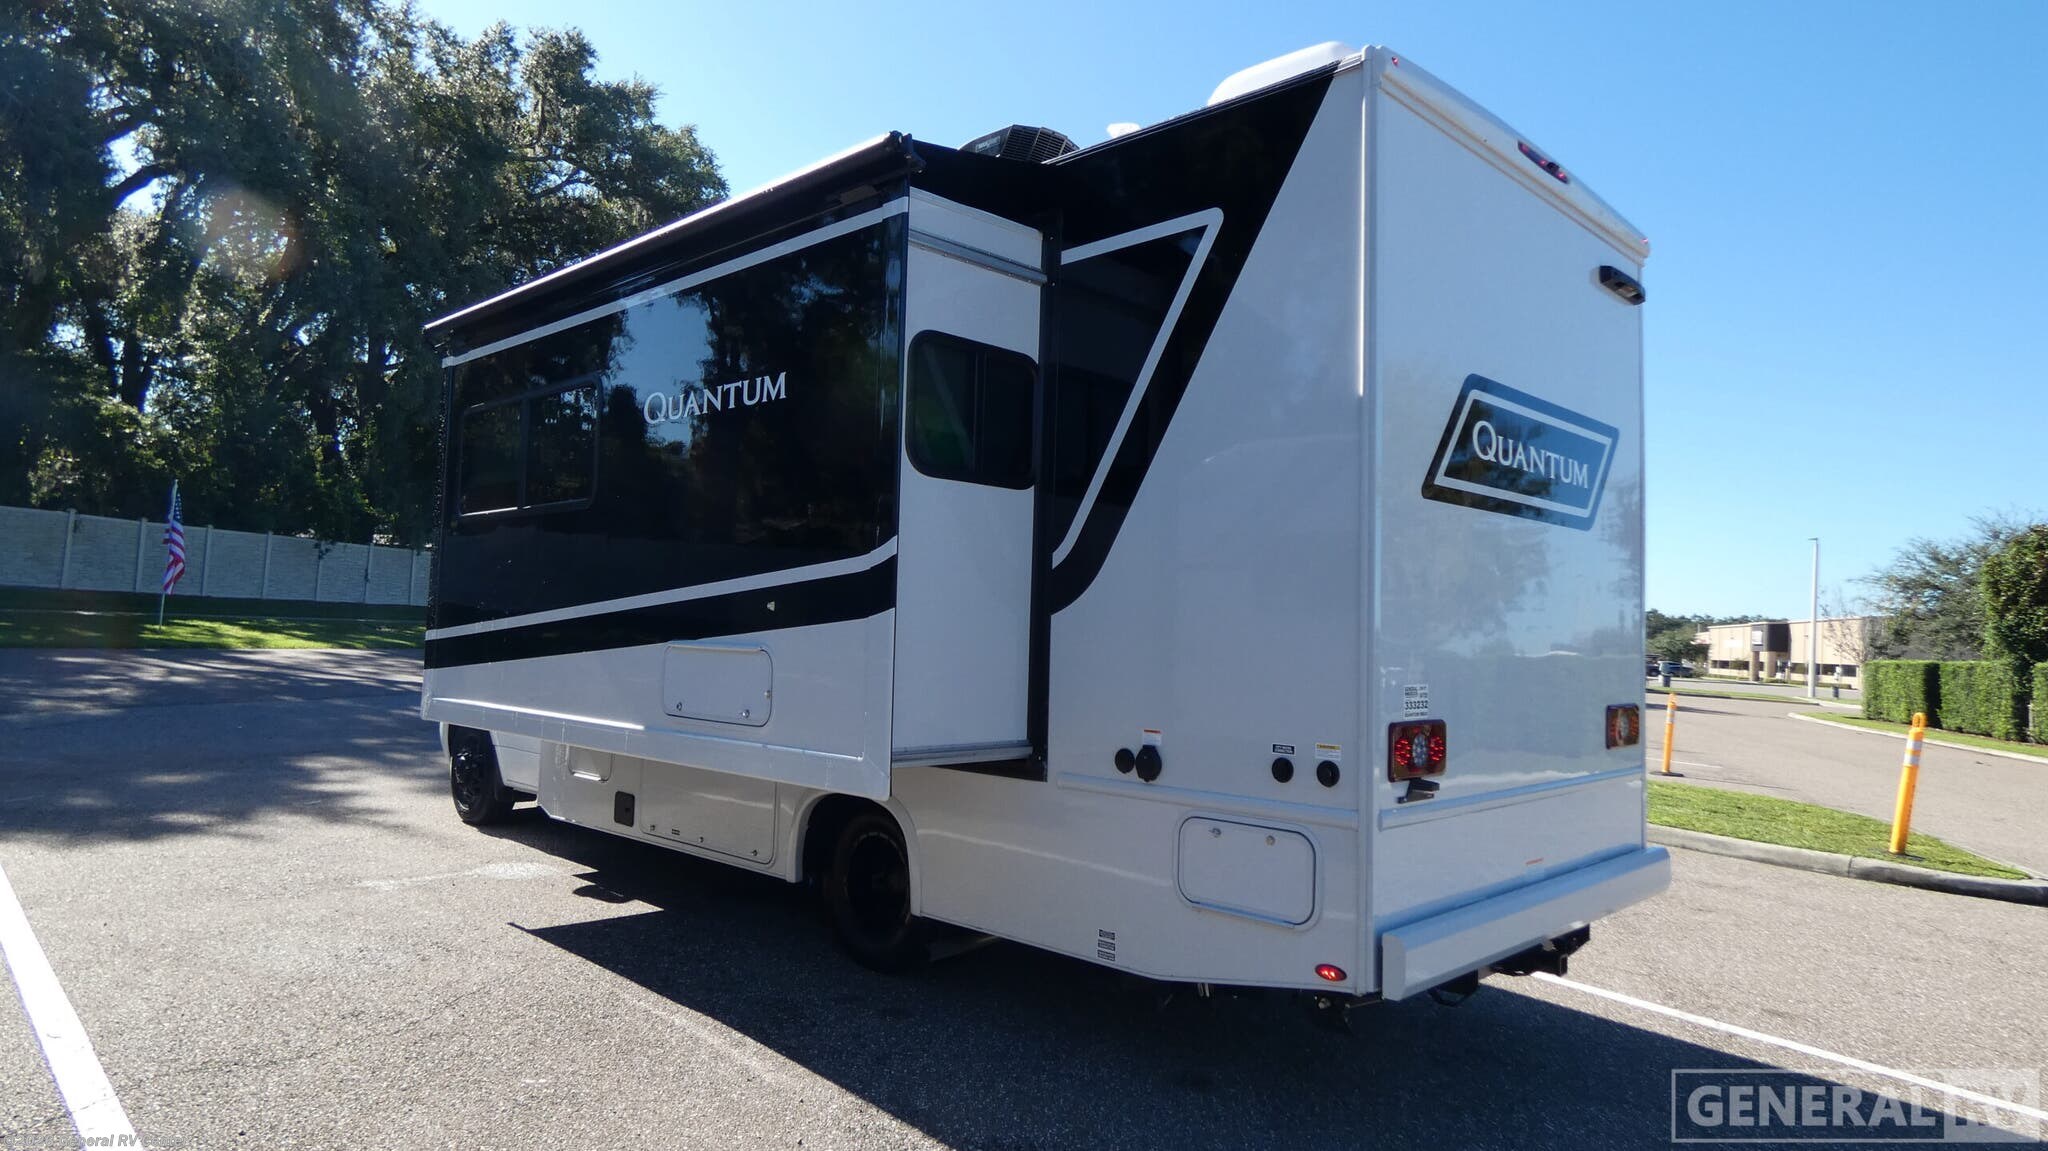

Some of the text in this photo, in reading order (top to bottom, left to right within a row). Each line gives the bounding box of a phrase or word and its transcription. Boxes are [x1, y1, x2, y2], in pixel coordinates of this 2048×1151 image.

[643, 371, 787, 425] QUANTUM
[1472, 420, 1589, 489] QUANTUM
[1405, 700, 1429, 711] 333232
